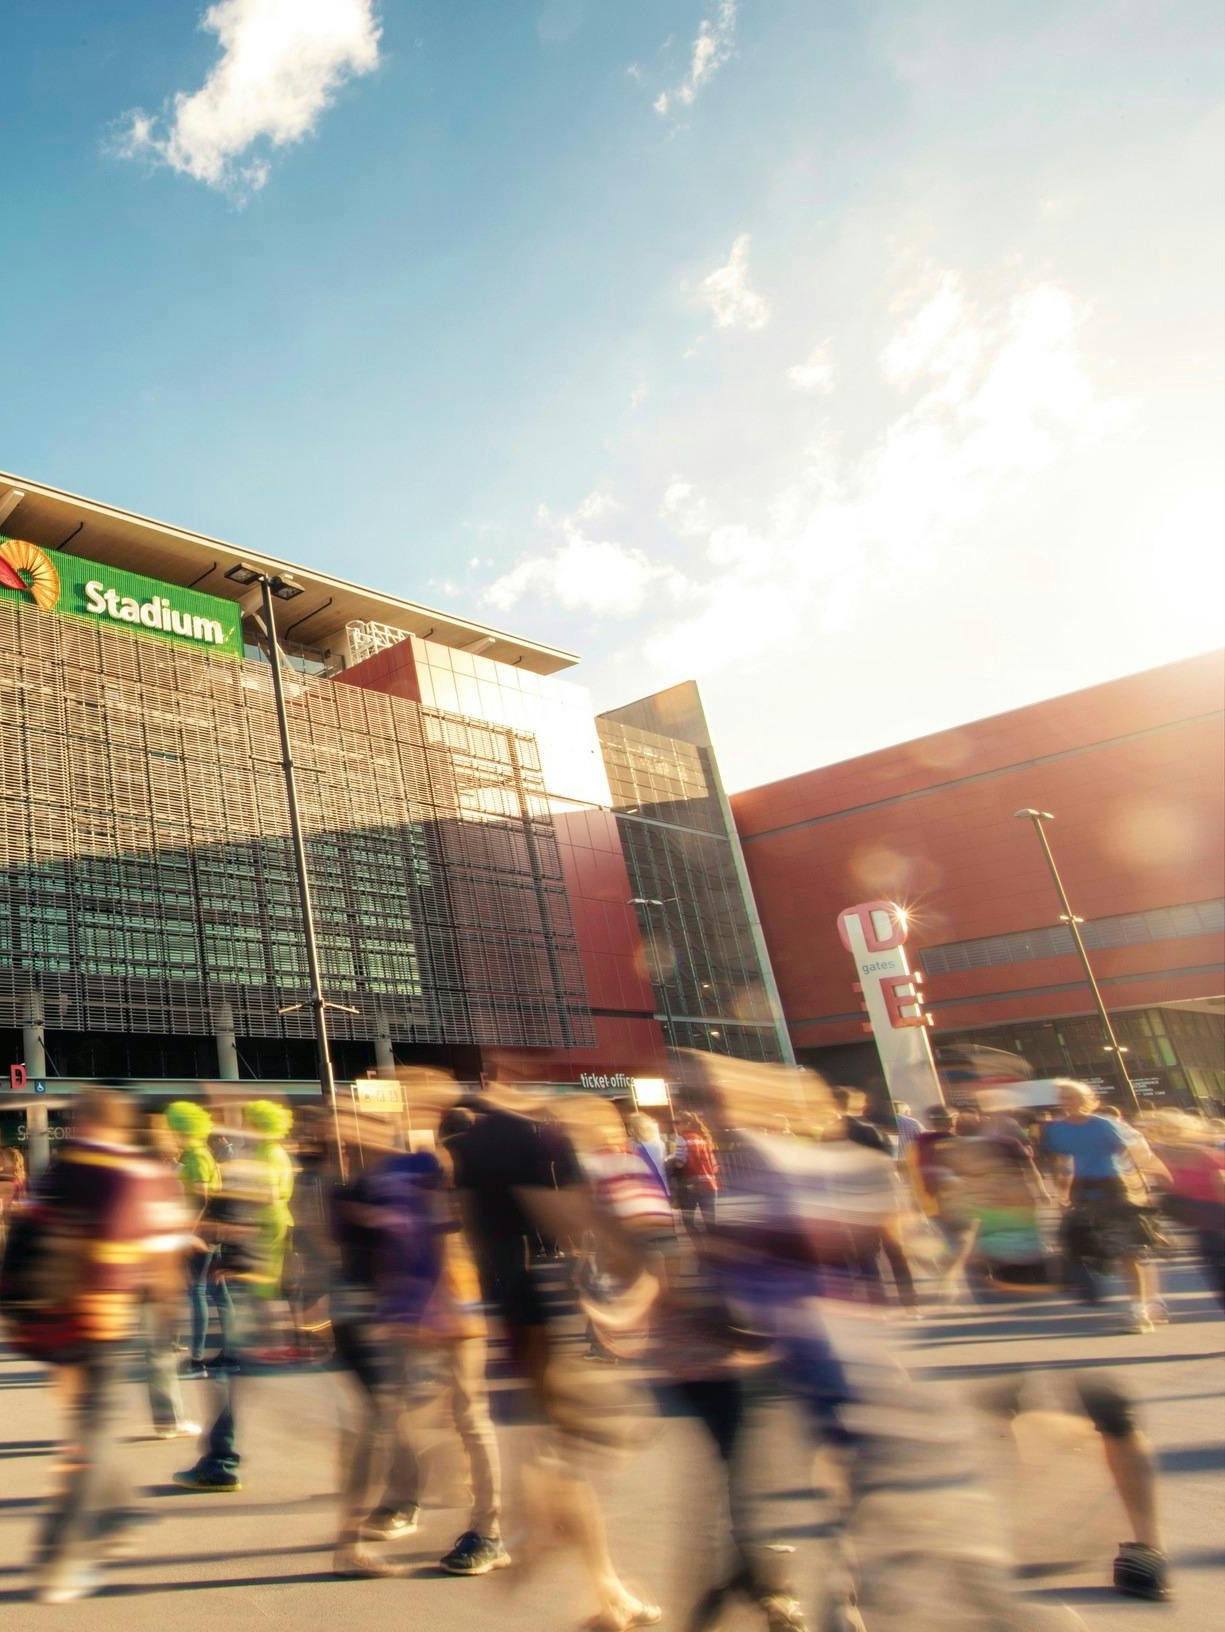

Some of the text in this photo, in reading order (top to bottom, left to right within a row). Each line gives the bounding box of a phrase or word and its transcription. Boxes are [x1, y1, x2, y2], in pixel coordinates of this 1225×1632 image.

[84, 580, 224, 644] Stadium
[855, 900, 908, 953] D
[862, 959, 896, 975] gates
[879, 974, 927, 1029] E
[9, 1064, 27, 1088] D
[580, 1072, 610, 1088] ticket
